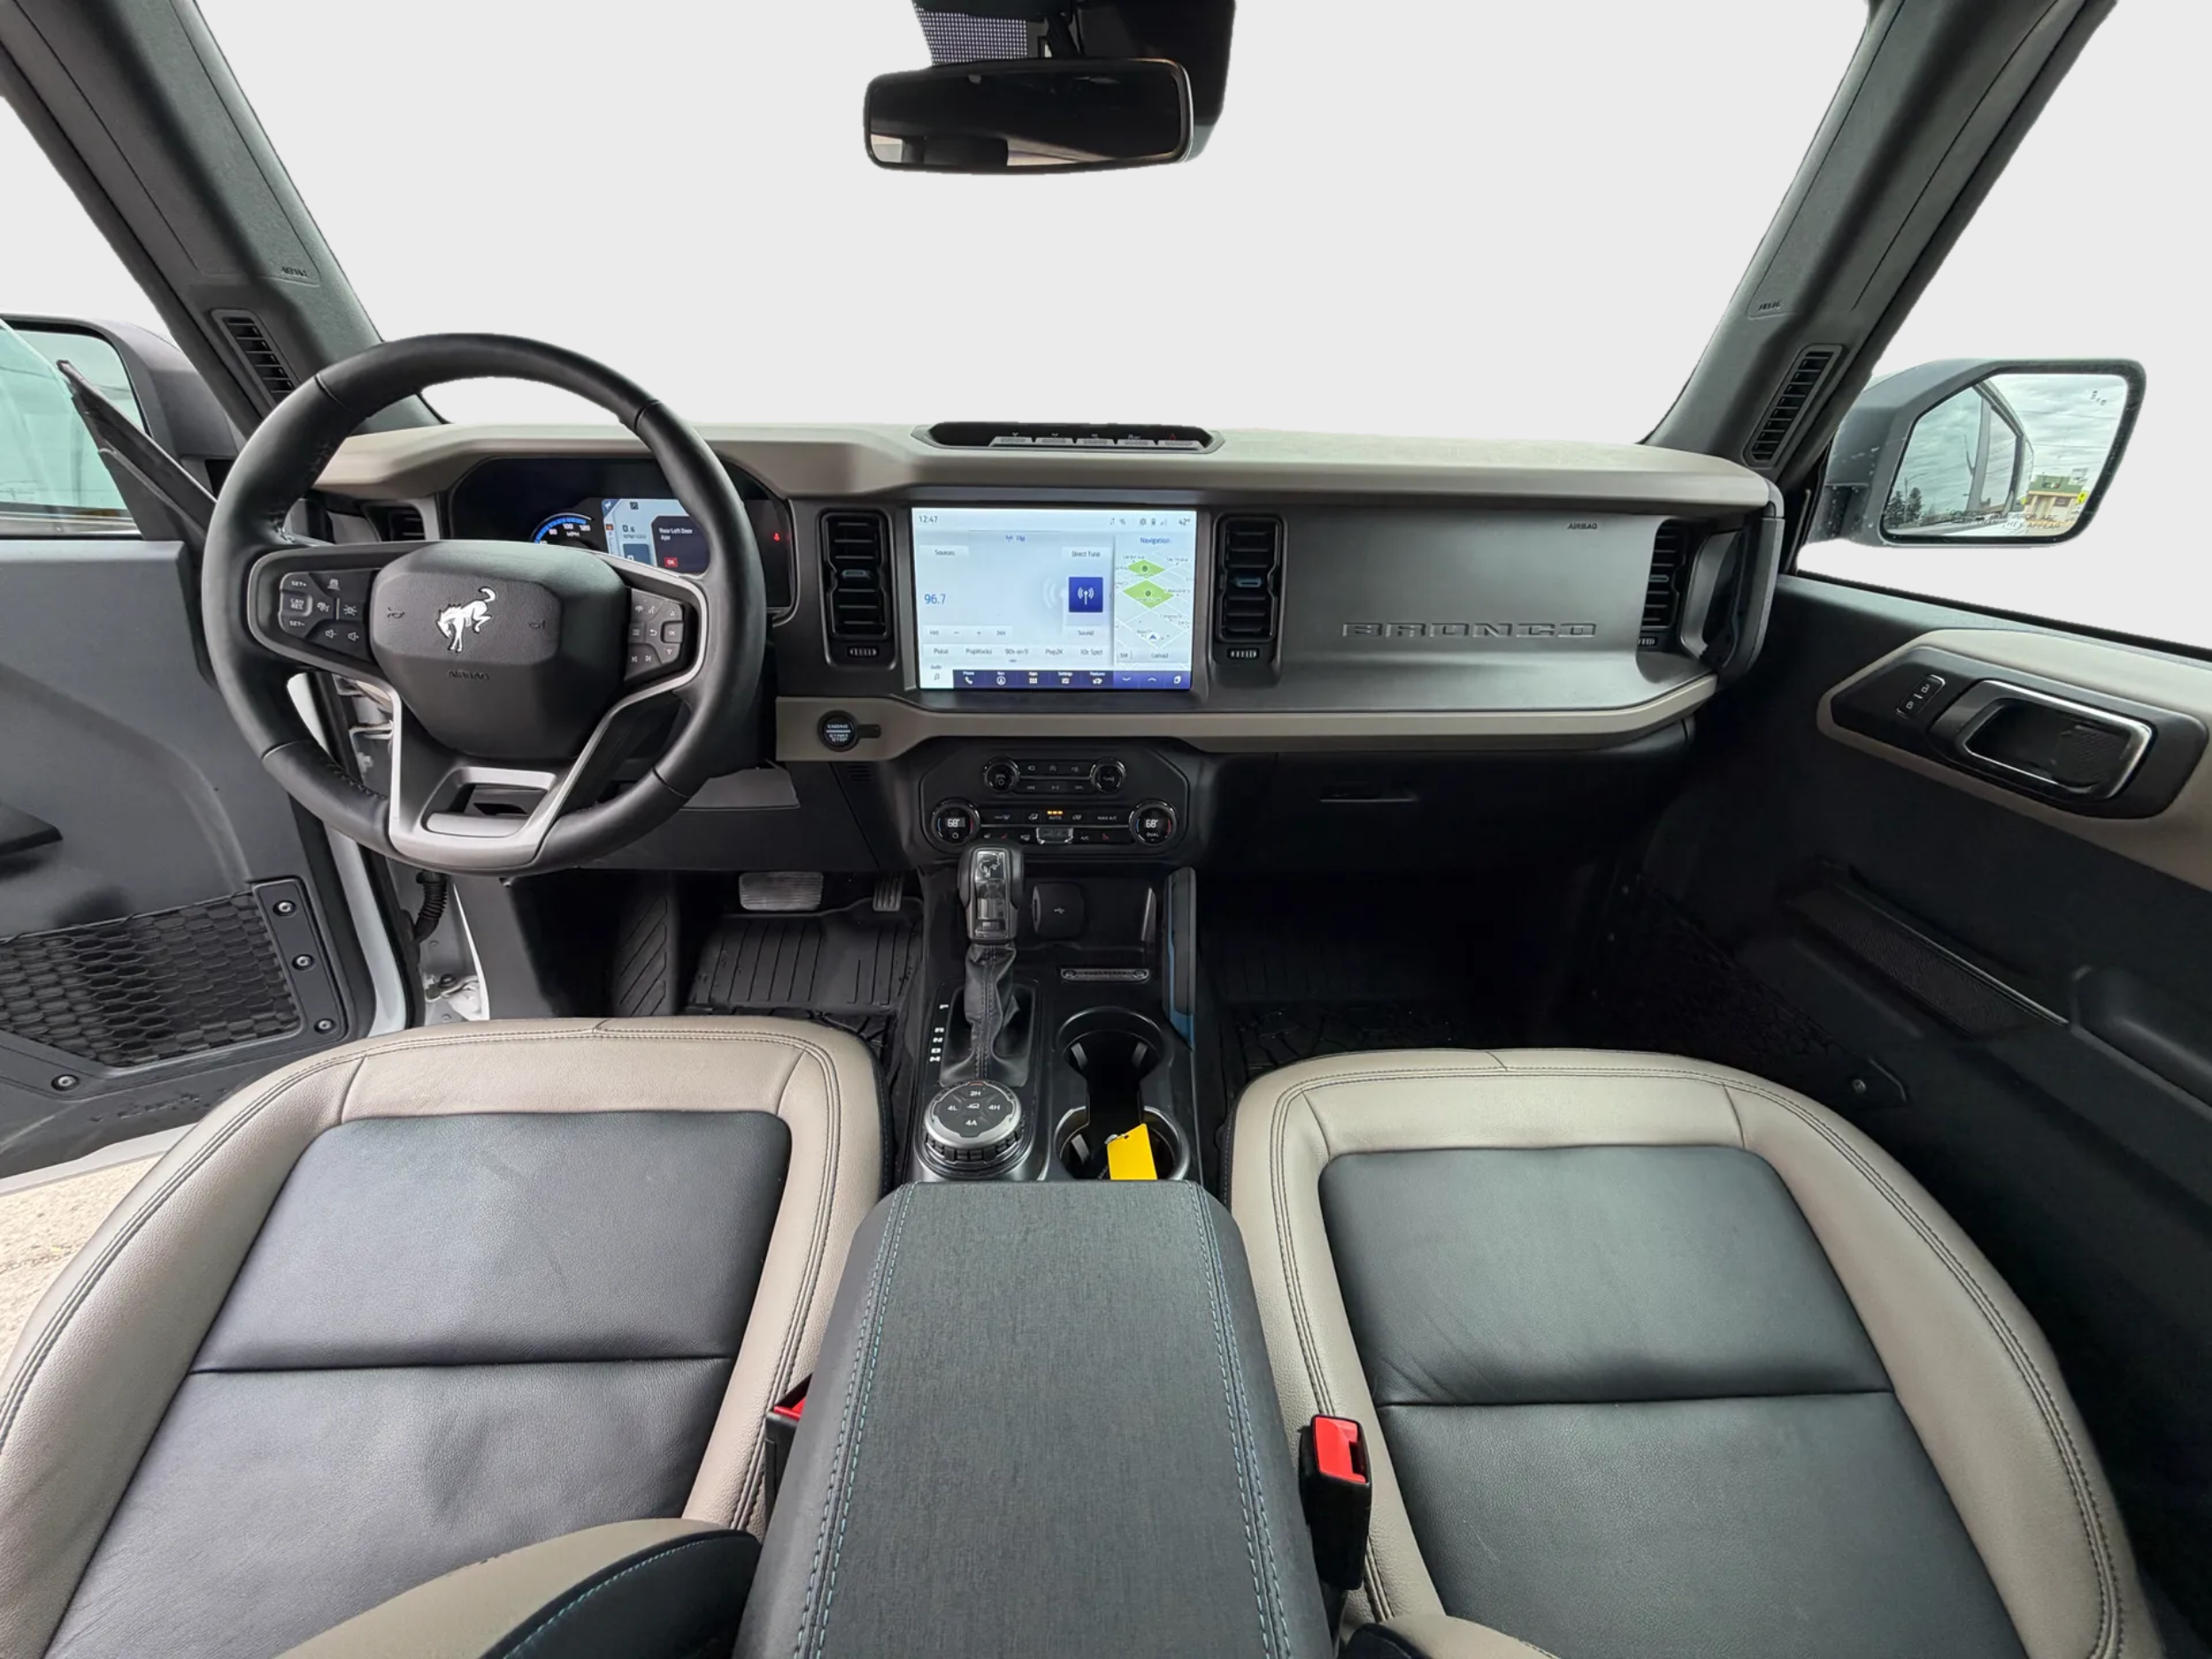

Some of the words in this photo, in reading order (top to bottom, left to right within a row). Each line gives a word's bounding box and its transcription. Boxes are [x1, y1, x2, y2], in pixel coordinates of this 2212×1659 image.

[1140, 536, 1171, 545] Navigation
[924, 593, 947, 604] 96.7
[1341, 623, 1597, 639] BRONCO
